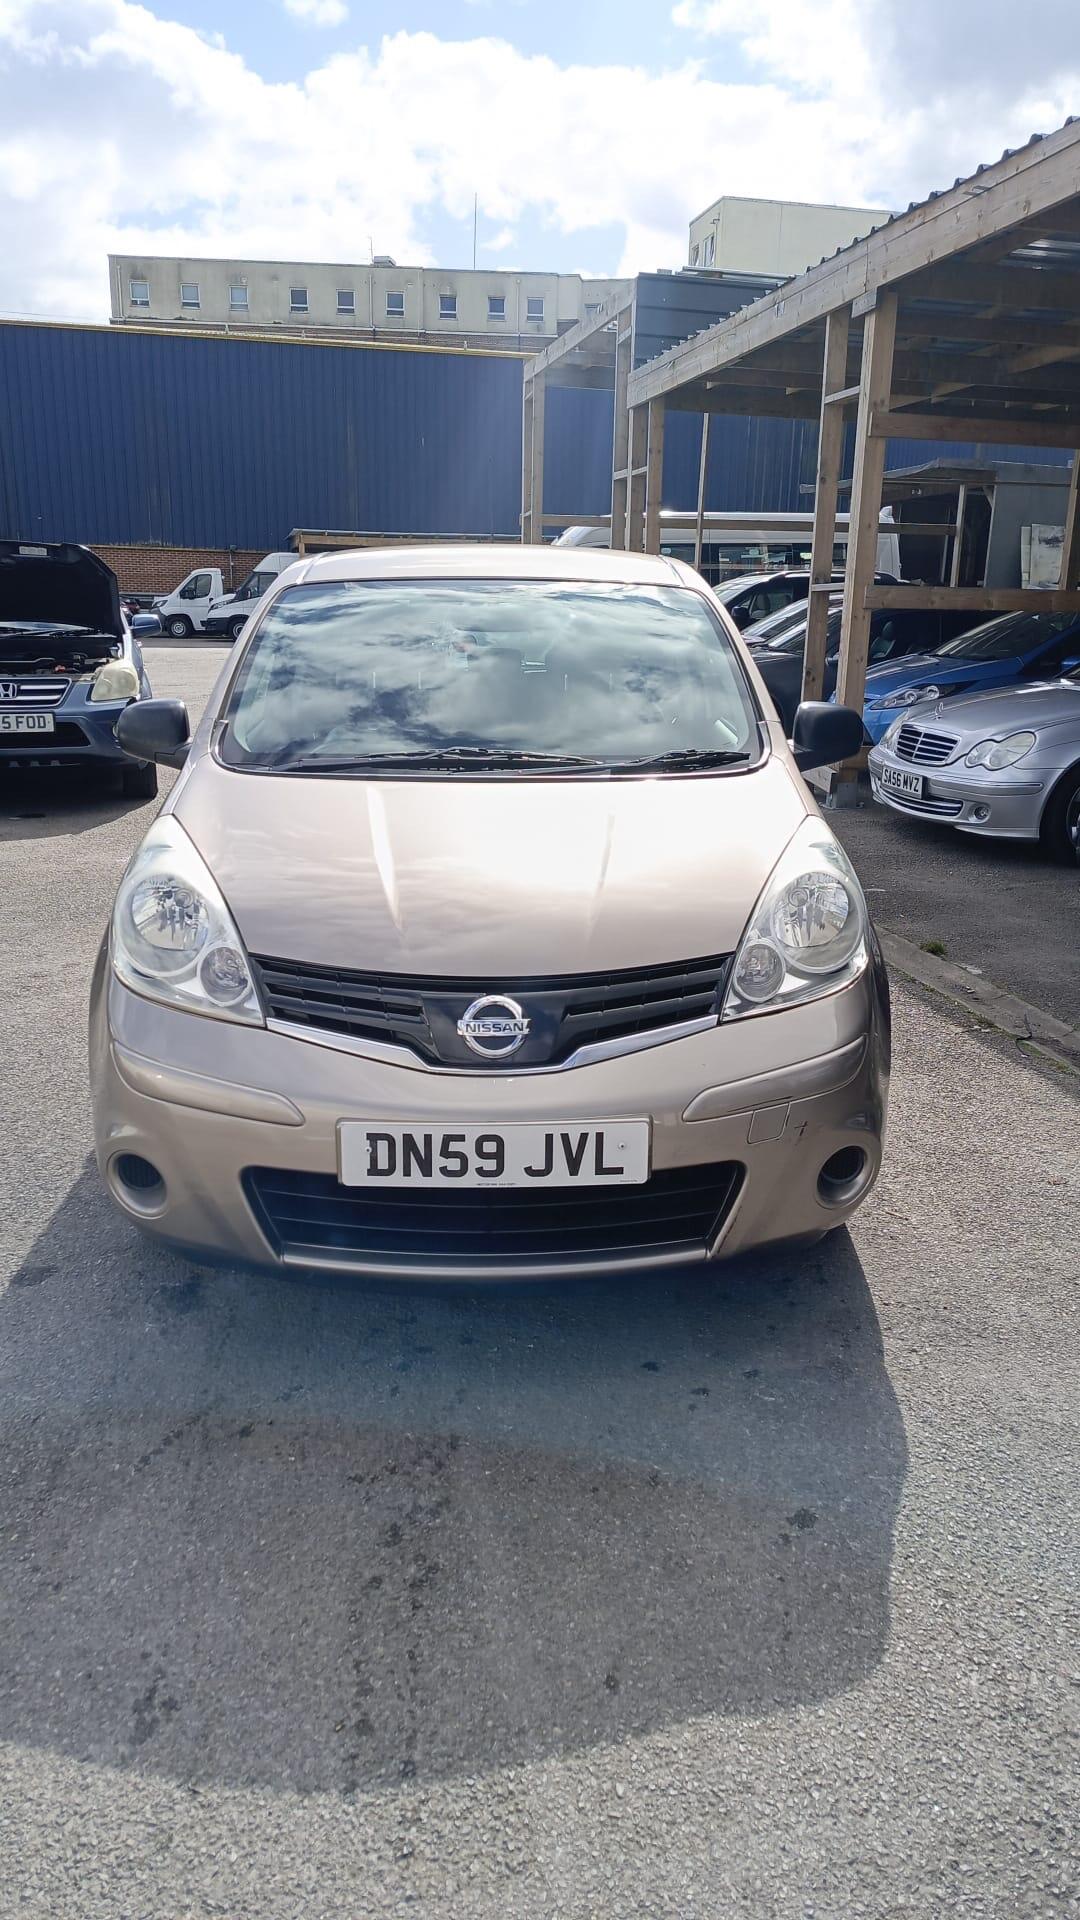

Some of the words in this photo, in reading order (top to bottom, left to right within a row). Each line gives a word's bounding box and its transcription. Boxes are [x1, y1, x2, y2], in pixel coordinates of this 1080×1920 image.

[15, 715, 47, 729] FOD
[883, 768, 902, 787] SA56
[902, 774, 920, 793] MVZ
[465, 1023, 524, 1033] NISSAN
[365, 1132, 505, 1178] DN59
[523, 1131, 624, 1178] JVL
